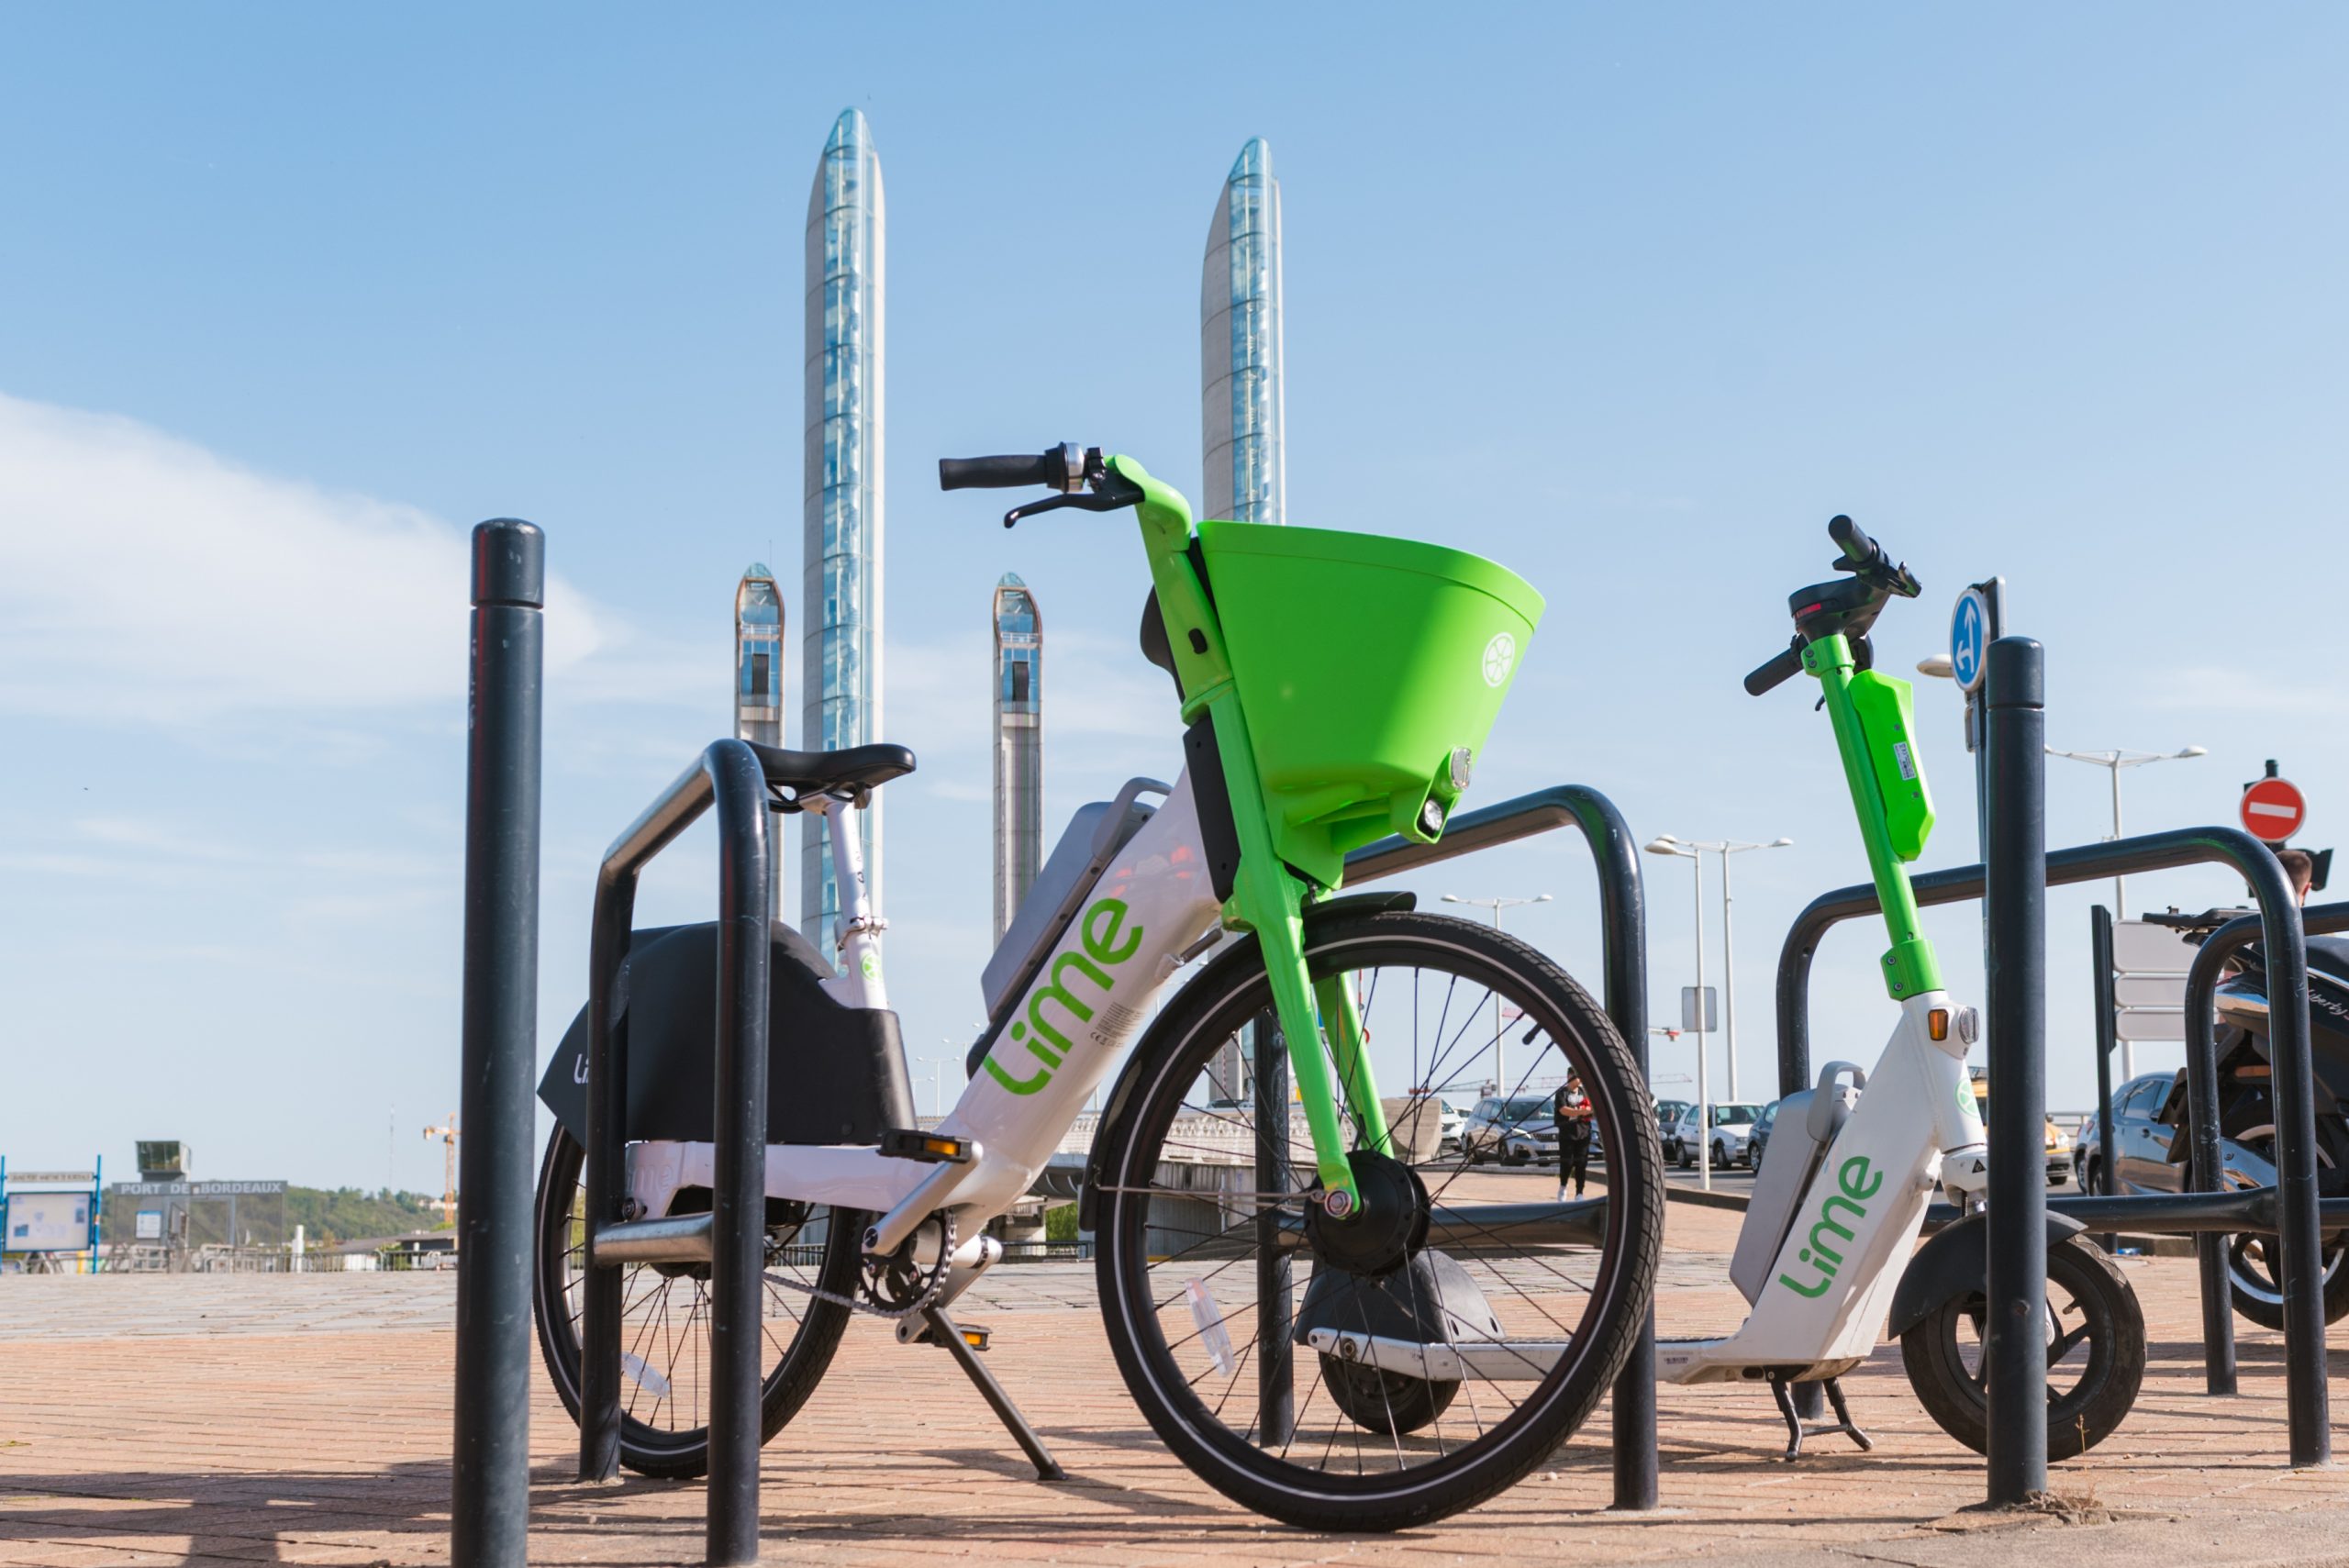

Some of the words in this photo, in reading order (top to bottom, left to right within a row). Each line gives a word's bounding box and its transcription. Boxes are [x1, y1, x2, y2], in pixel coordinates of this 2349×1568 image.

[984, 897, 1143, 1095] Lime
[2308, 989, 2348, 1015] iberty
[120, 1184, 161, 1195] PORT
[170, 1183, 190, 1195] DE
[200, 1182, 282, 1194] BORDEAUX
[1778, 1155, 1884, 1298] Lime
